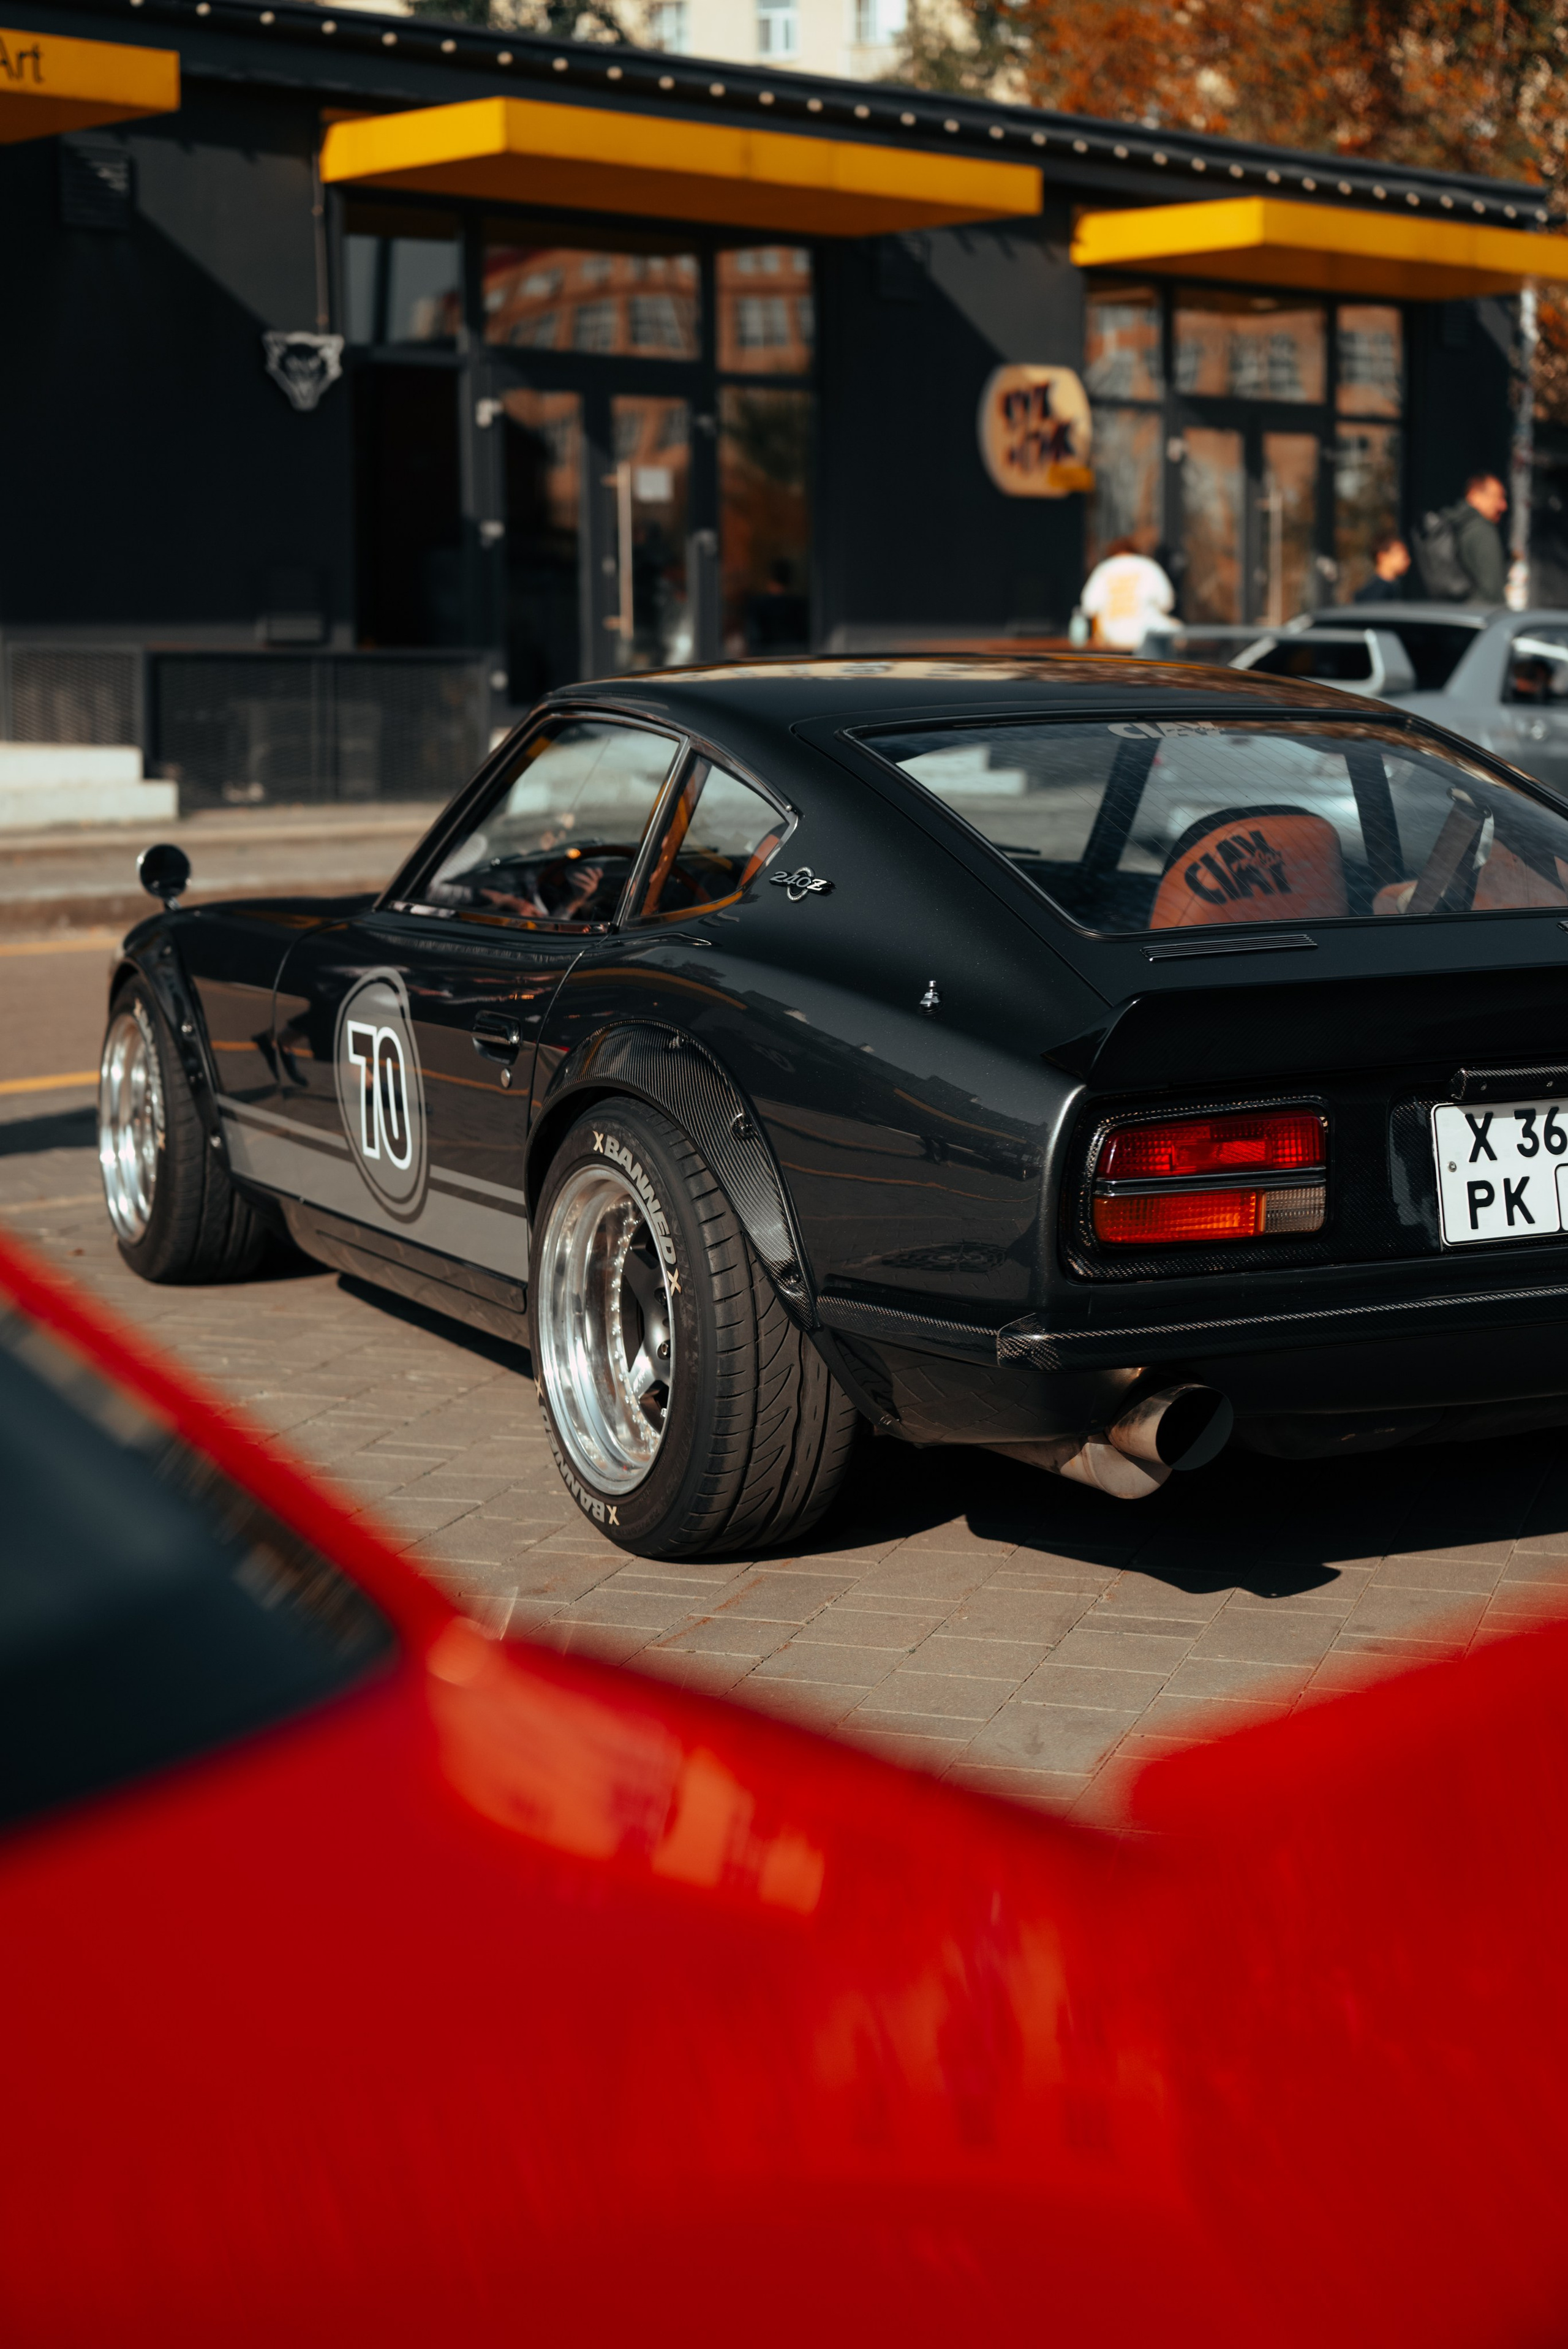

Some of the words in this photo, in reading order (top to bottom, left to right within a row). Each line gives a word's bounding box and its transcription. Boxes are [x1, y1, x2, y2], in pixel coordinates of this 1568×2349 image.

[347, 1019, 412, 1171] 70
[1464, 1111, 1498, 1163] X
[1514, 1106, 1568, 1158] 36
[604, 1134, 677, 1265] BANNED
[1467, 1176, 1536, 1230] PK
